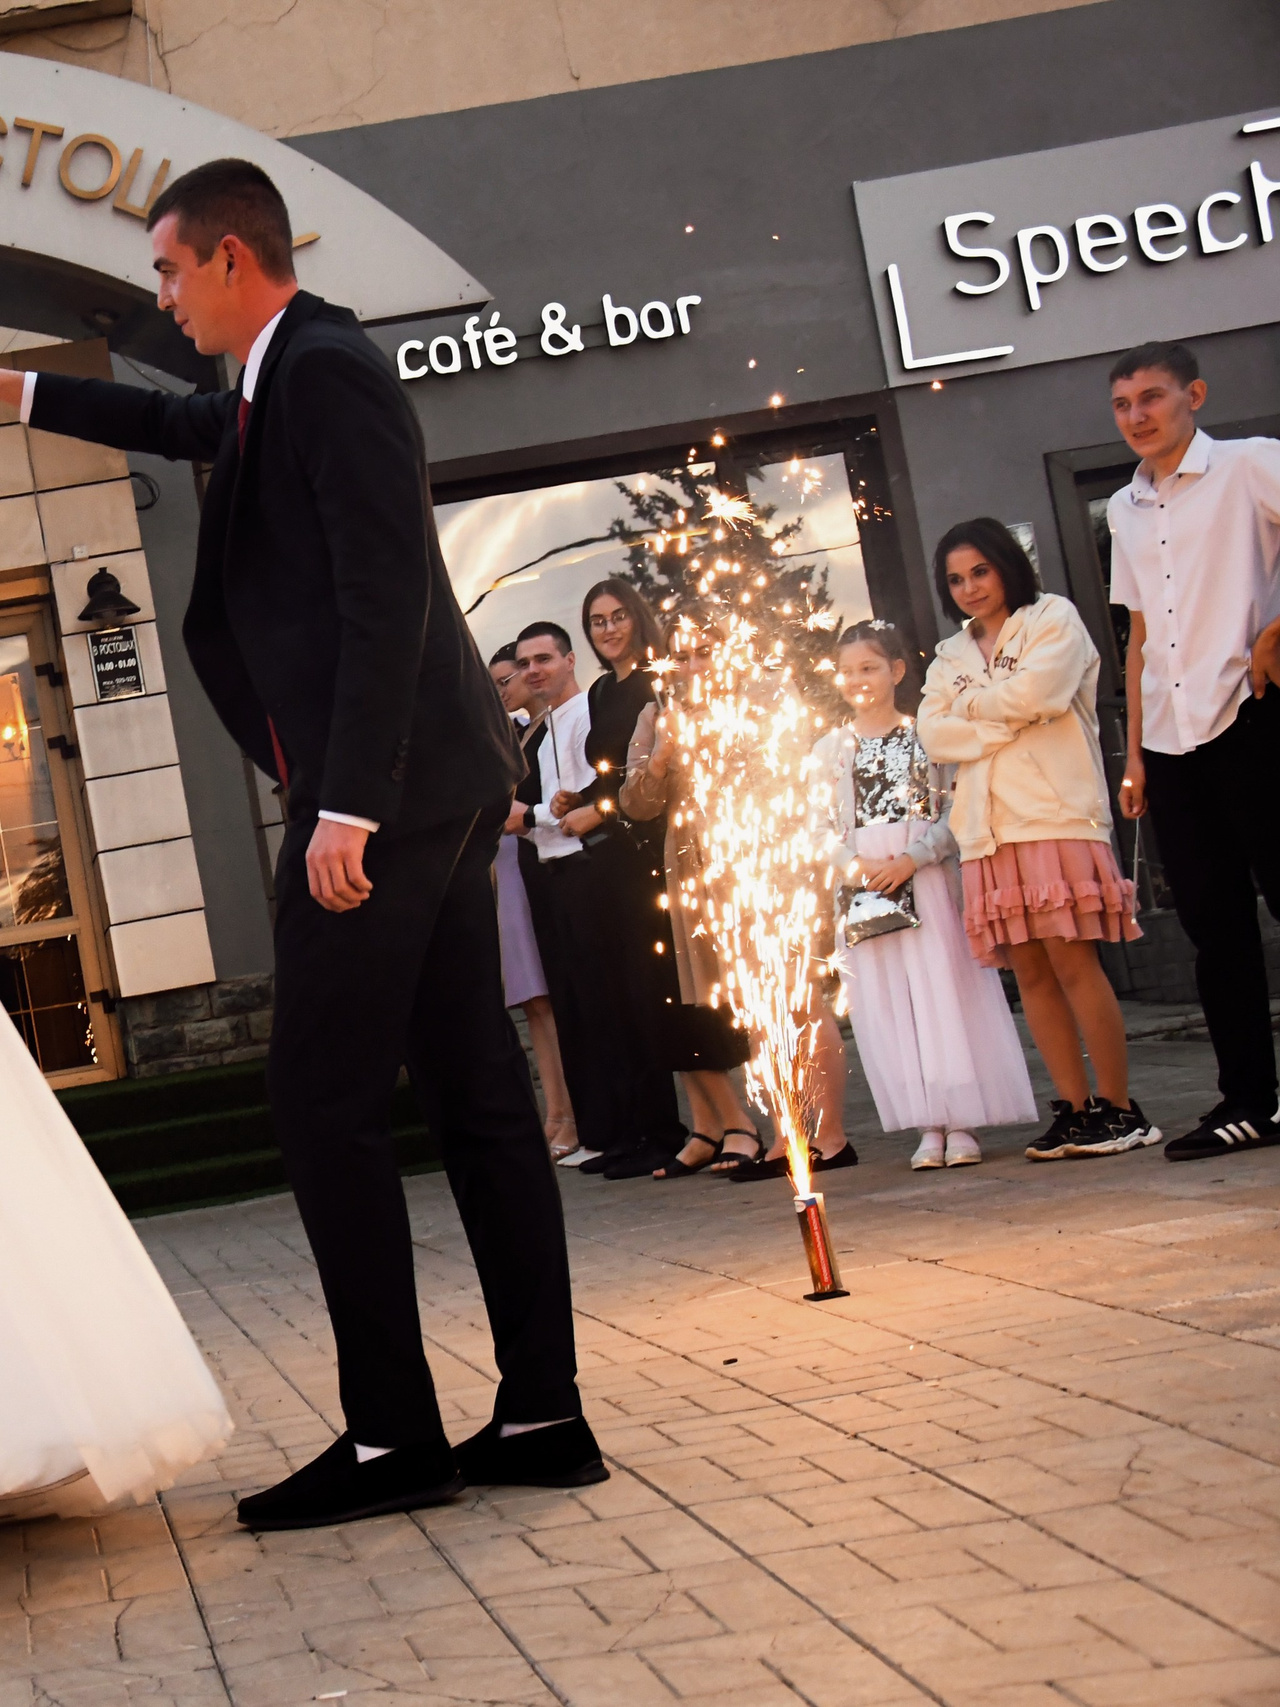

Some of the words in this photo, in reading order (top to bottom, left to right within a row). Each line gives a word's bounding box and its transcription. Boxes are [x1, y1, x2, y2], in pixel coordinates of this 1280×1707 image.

[944, 160, 1280, 310] Speech
[396, 312, 519, 381] café
[540, 302, 585, 357] &
[602, 294, 702, 347] bar
